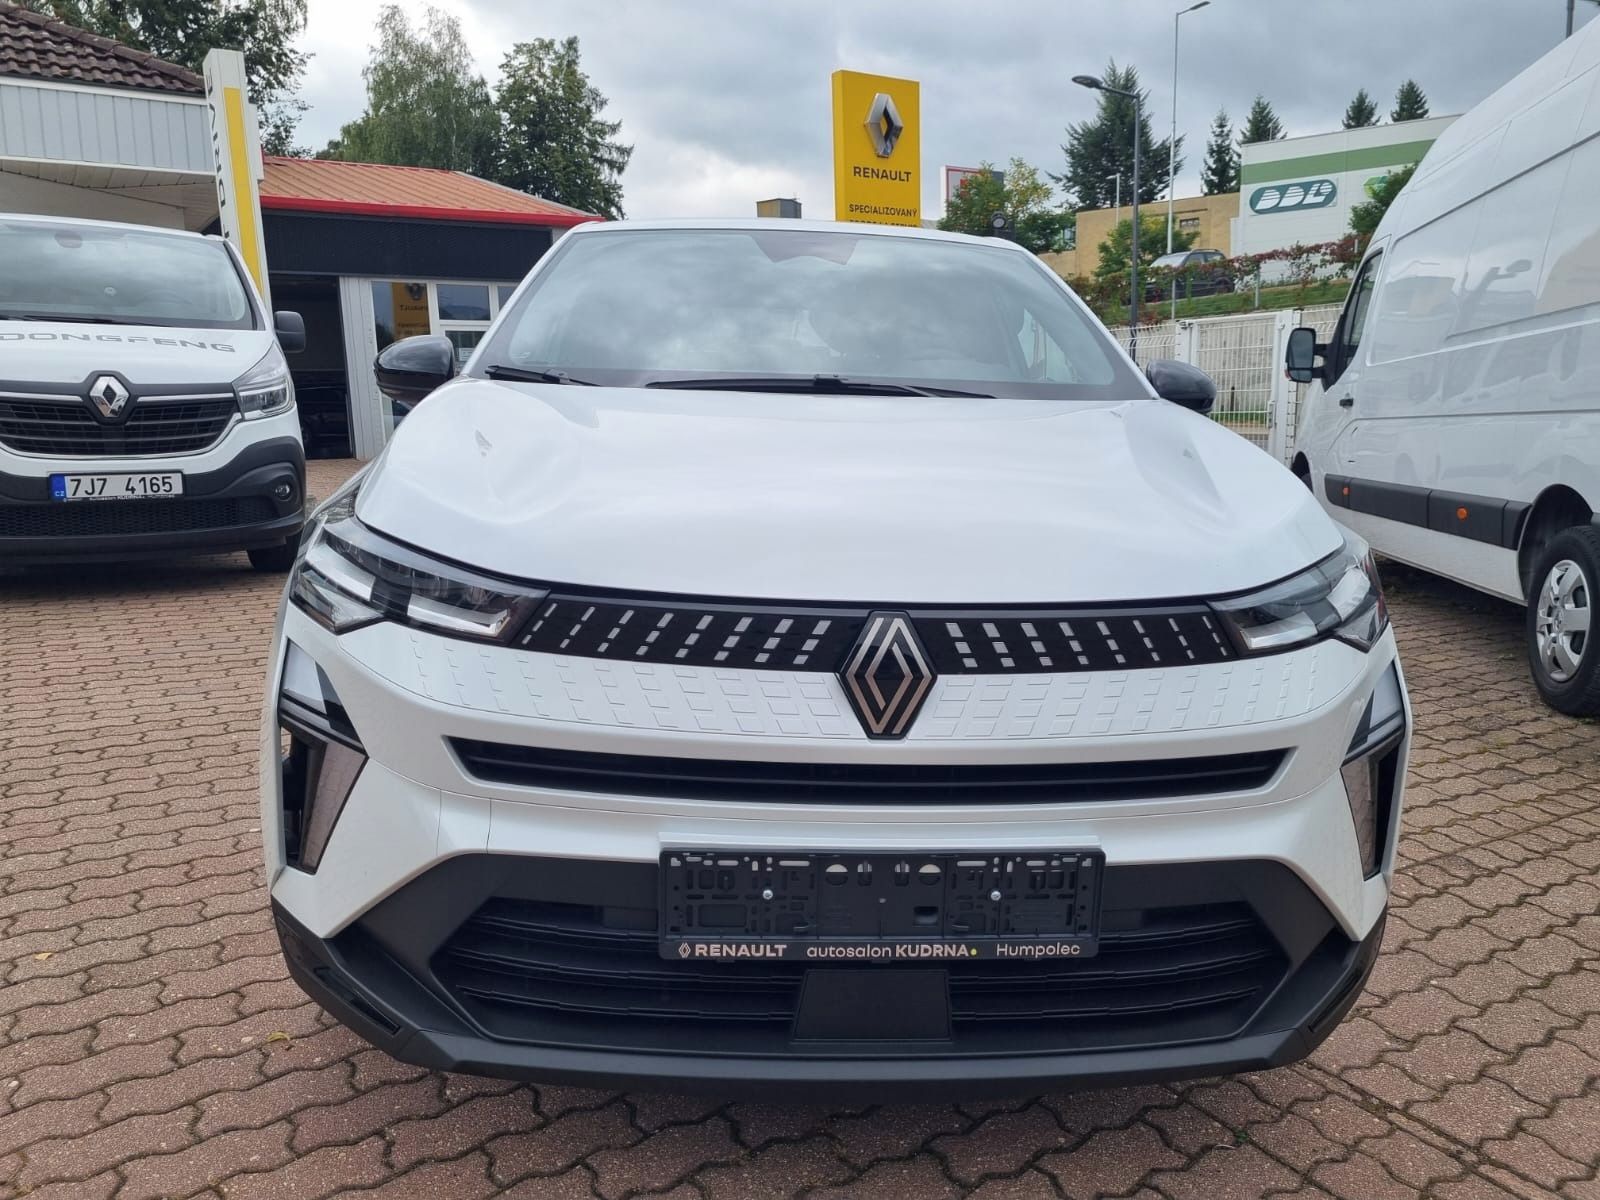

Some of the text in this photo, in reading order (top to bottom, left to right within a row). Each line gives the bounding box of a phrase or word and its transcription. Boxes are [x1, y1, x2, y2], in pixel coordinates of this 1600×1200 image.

[853, 166, 912, 182] RENAULT
[848, 203, 918, 217] SPECIALIZOVANÝ
[0, 332, 236, 352] DONGFENG
[70, 476, 173, 496] 7J7 4165
[695, 944, 787, 957] RENAULT
[806, 944, 892, 958] autosalon
[996, 942, 1081, 958] Humpolec
